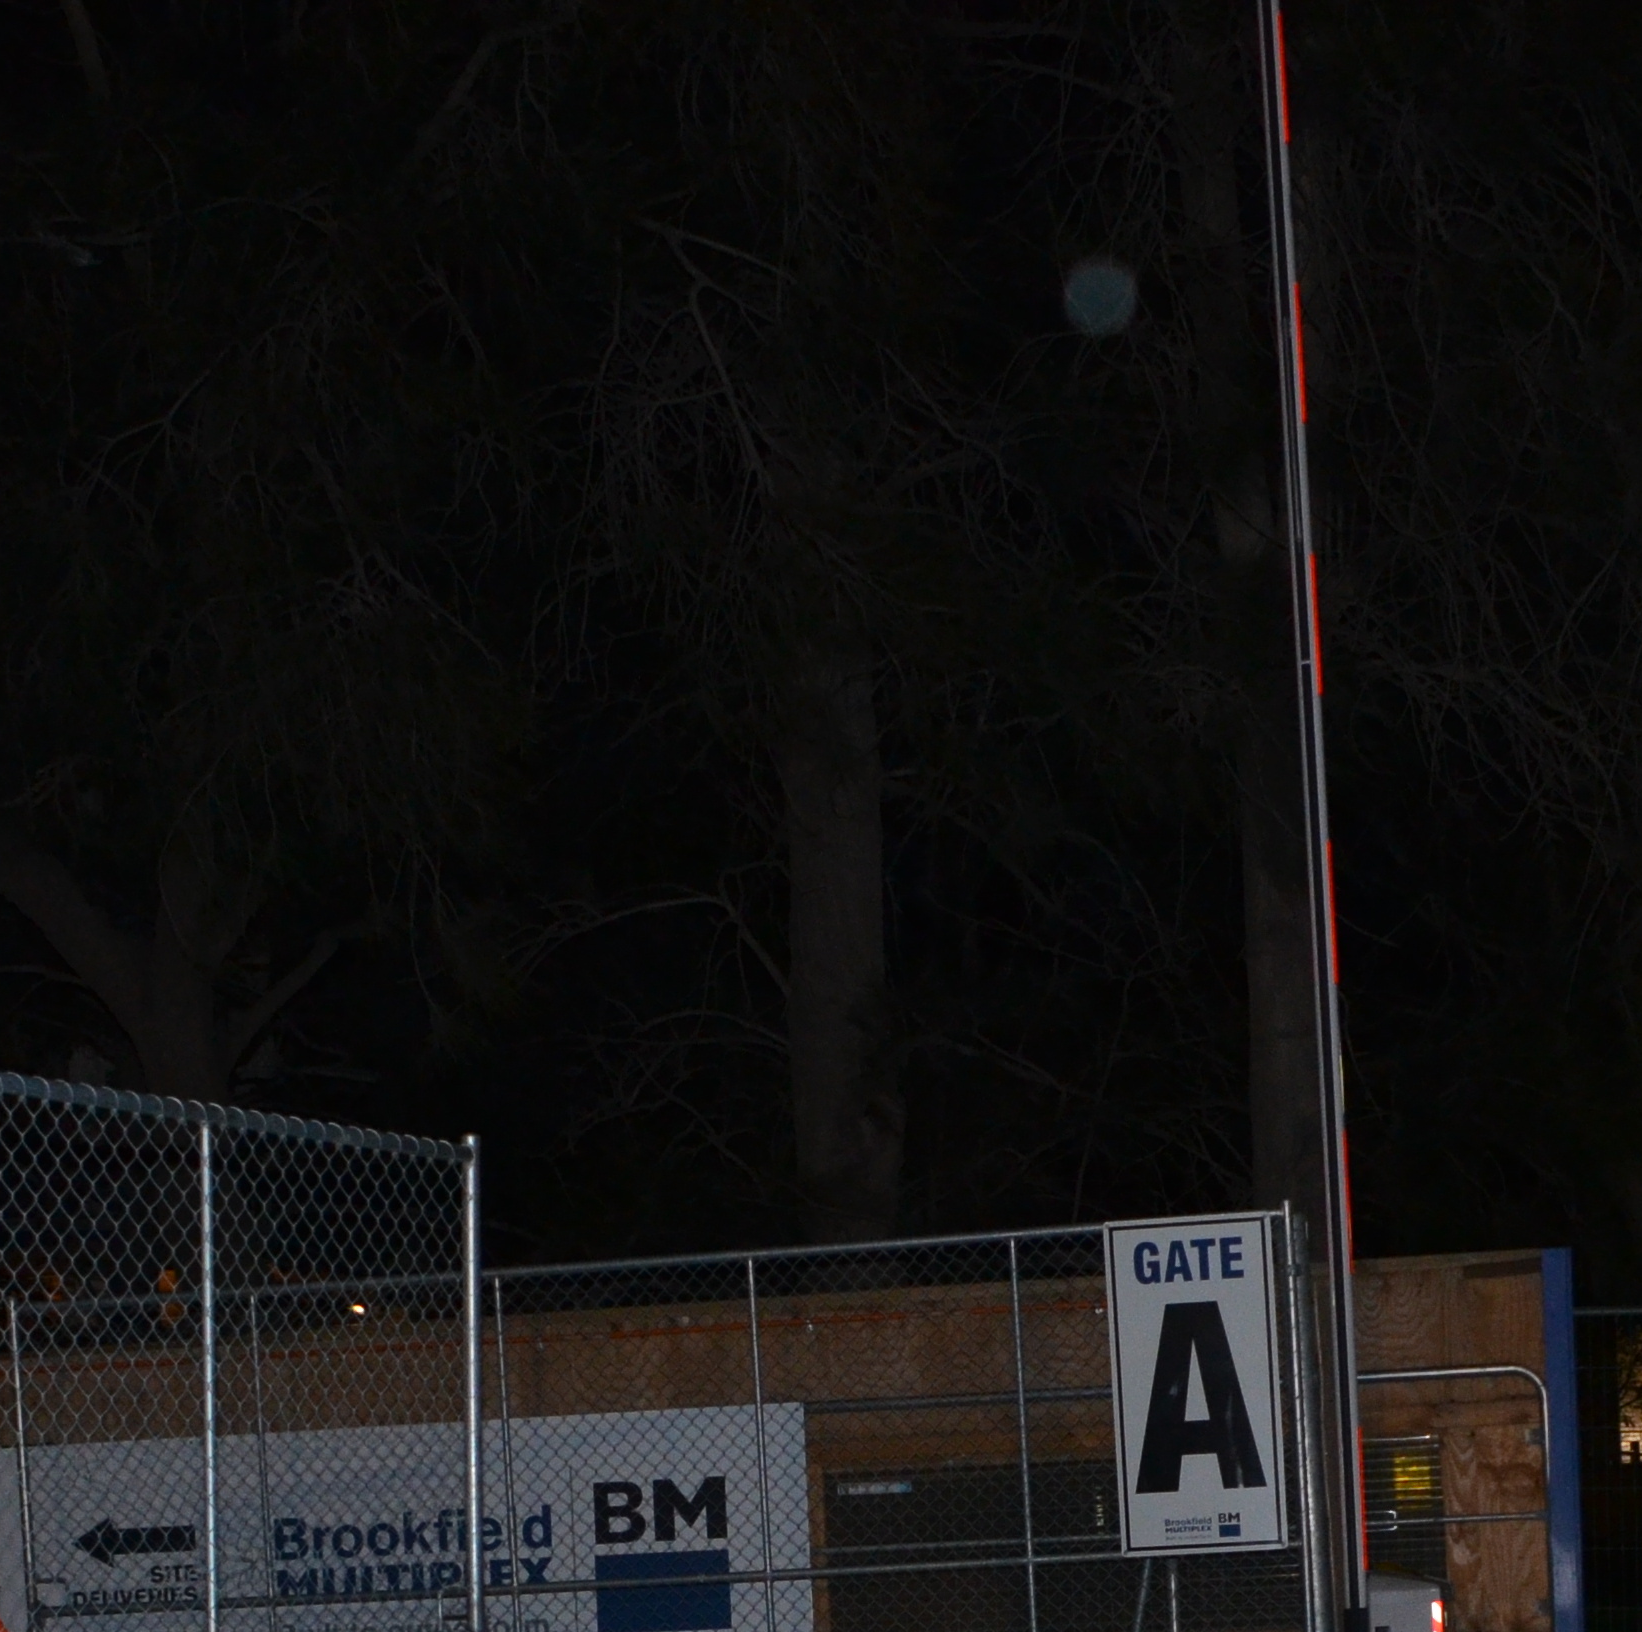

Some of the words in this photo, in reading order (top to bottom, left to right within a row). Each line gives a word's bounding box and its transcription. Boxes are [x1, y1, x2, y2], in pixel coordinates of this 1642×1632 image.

[1133, 1236, 1245, 1285] GATE
[1135, 1300, 1267, 1494] A
[274, 1504, 553, 1560] Brookfied
[593, 1476, 728, 1545] BM
[1218, 1512, 1241, 1523] BM
[151, 1564, 199, 1583] SITE
[276, 1556, 552, 1597] MULTIPEX
